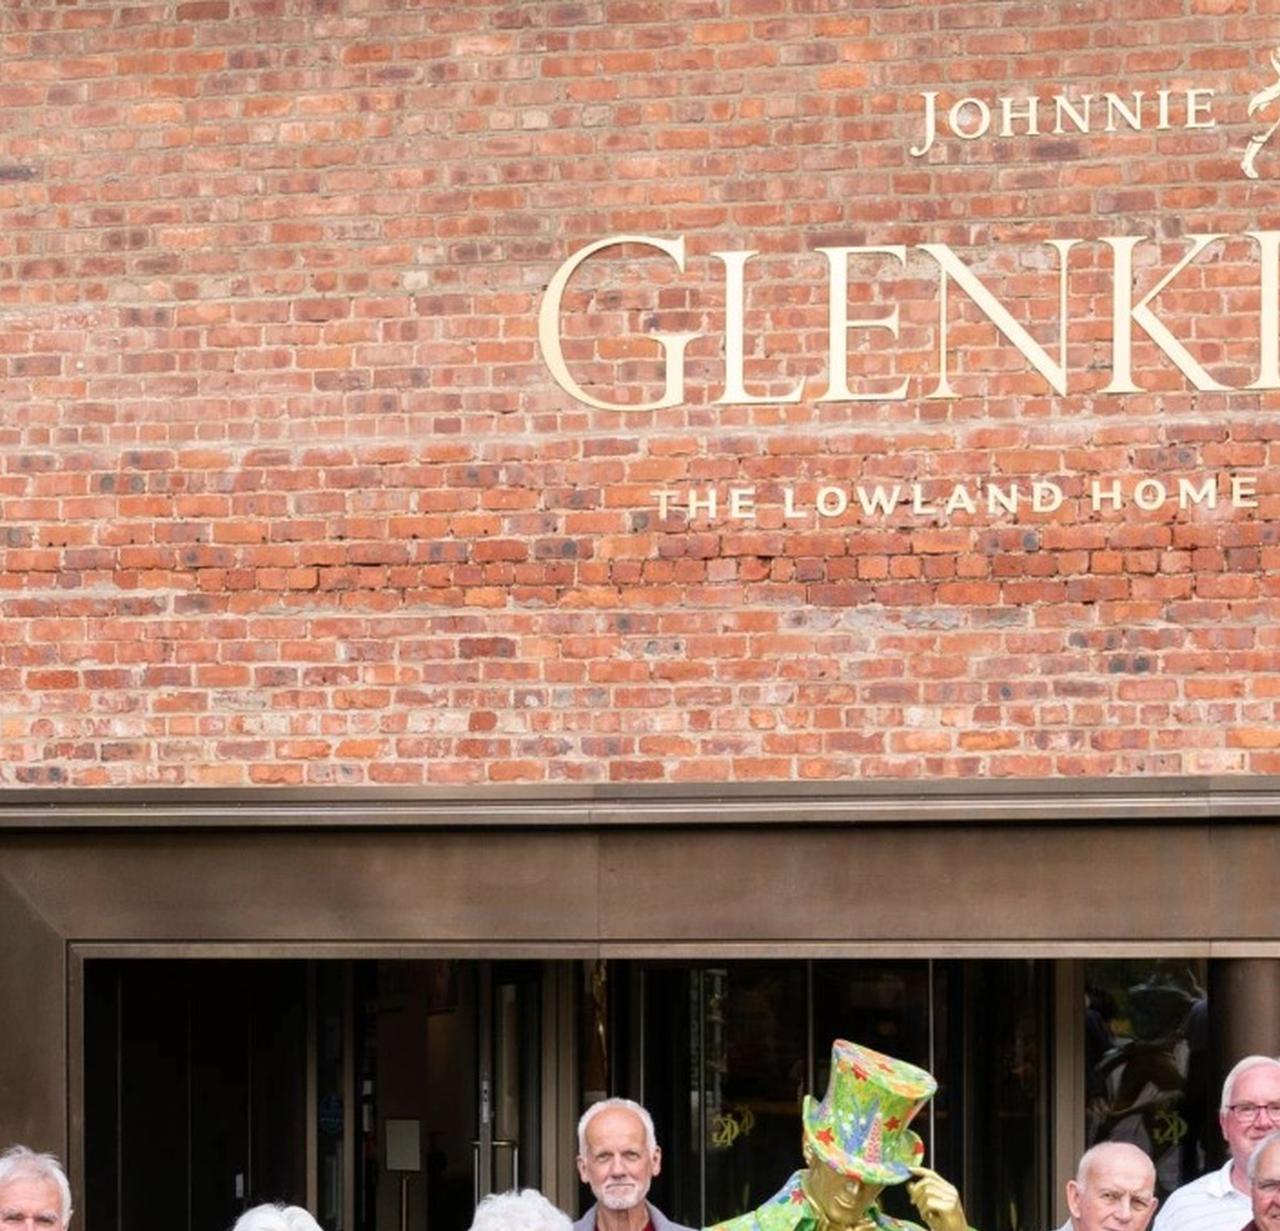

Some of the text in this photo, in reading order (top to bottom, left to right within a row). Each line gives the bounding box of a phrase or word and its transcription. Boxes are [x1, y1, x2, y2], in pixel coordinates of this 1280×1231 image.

[910, 87, 1218, 157] JOHNNIE
[651, 488, 757, 520] THE
[783, 483, 1065, 518] LOWLAND
[1091, 476, 1260, 511] HOME
